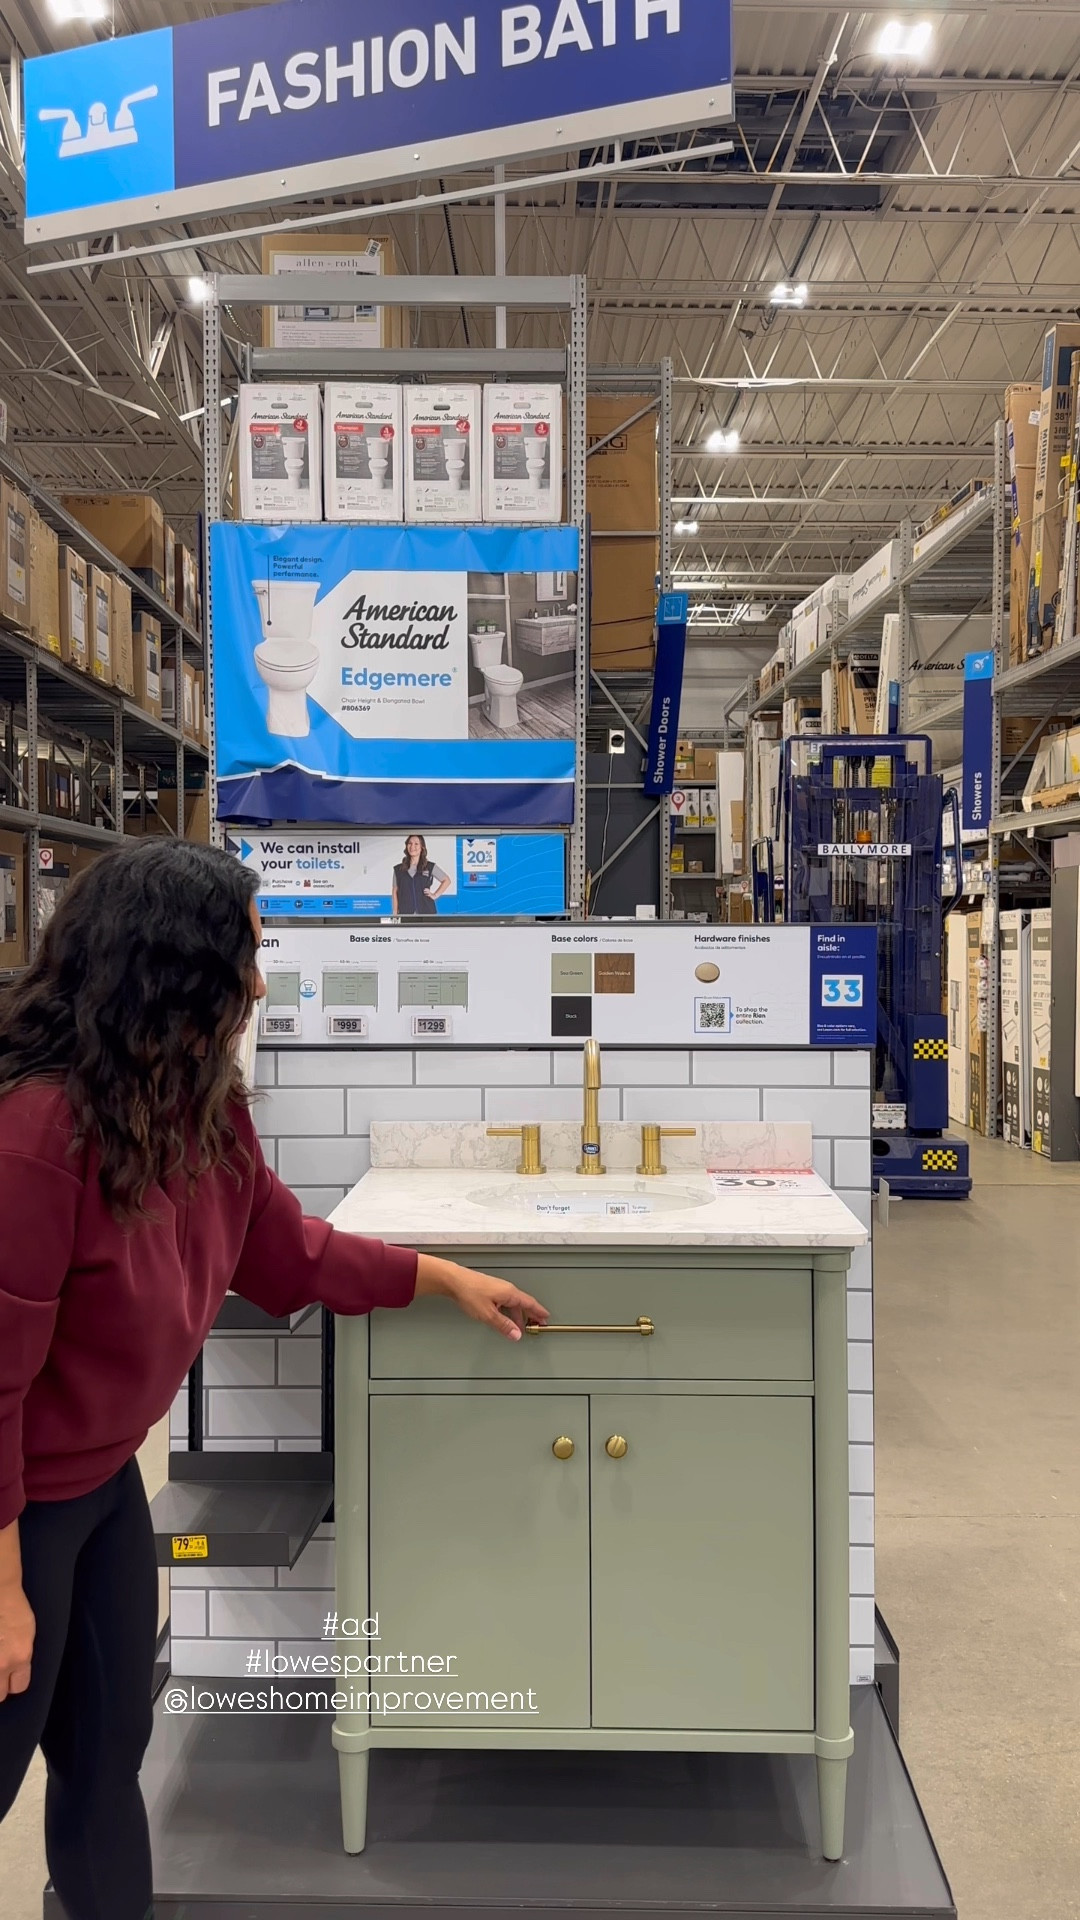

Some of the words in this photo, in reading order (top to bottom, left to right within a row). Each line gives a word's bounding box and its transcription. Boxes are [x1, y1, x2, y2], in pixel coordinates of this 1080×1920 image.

[207, 15, 475, 128] FASHION
[502, 0, 680, 67] BATH
[296, 259, 324, 268] allen
[335, 259, 358, 268] roth
[251, 412, 279, 420] American
[335, 411, 364, 420] American
[365, 411, 393, 420] Standard
[412, 413, 441, 421] American
[493, 412, 522, 420] American
[522, 412, 551, 420] Standard
[273, 555, 298, 564] Elegant
[300, 556, 324, 564] design.
[273, 570, 319, 578] performance.
[342, 594, 458, 622] American
[341, 622, 450, 650] Standard
[357, 697, 376, 706] Height
[382, 698, 411, 706] Elongated
[658, 696, 671, 734] Doors
[653, 736, 667, 784] Shower
[972, 771, 982, 821] Showers
[260, 842, 284, 854] We
[287, 844, 314, 854] can
[317, 842, 360, 854] install
[822, 844, 908, 854] BALLYMORE
[260, 860, 293, 871] your
[296, 857, 345, 870] toilets.
[350, 934, 370, 943] Base
[371, 934, 392, 943] sizes
[551, 934, 571, 943] Base
[573, 934, 598, 943] colors
[694, 934, 737, 943] Hardware
[738, 934, 771, 943] finishes
[817, 934, 836, 943] Find
[837, 934, 846, 943] in
[817, 944, 841, 952] aisle:
[824, 979, 861, 1003] 33
[270, 1021, 291, 1030] $599
[337, 1021, 357, 1030] $999
[419, 1021, 445, 1030] $1299
[552, 1204, 571, 1212] forget
